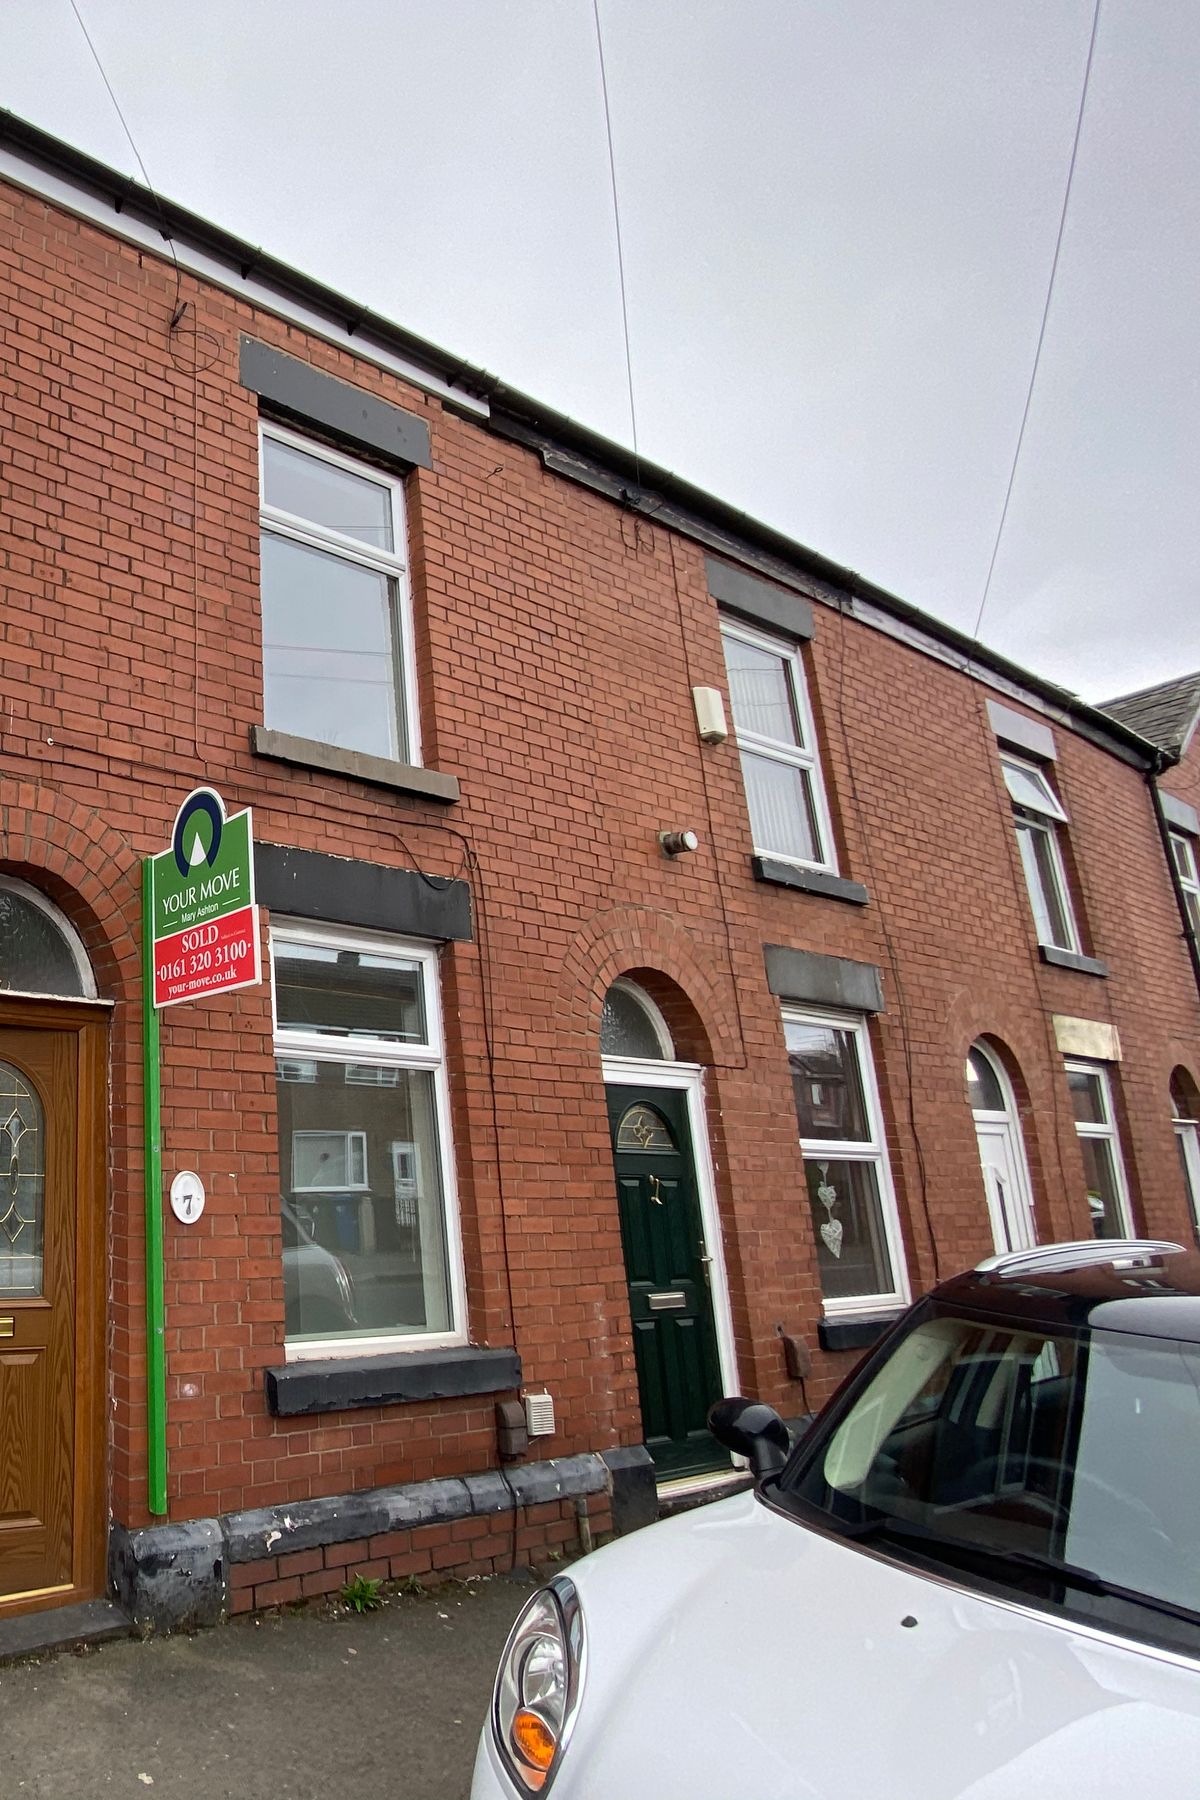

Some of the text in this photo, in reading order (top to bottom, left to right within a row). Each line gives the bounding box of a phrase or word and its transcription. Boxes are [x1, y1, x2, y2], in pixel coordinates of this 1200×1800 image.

[162, 867, 240, 915] YOUR MOVE
[181, 902, 219, 923] Mary Ashton
[181, 925, 219, 953] SOLD
[160, 939, 247, 982] 0161 320 3100
[168, 964, 237, 999] your-move.co.uk
[183, 1195, 193, 1215] 7
